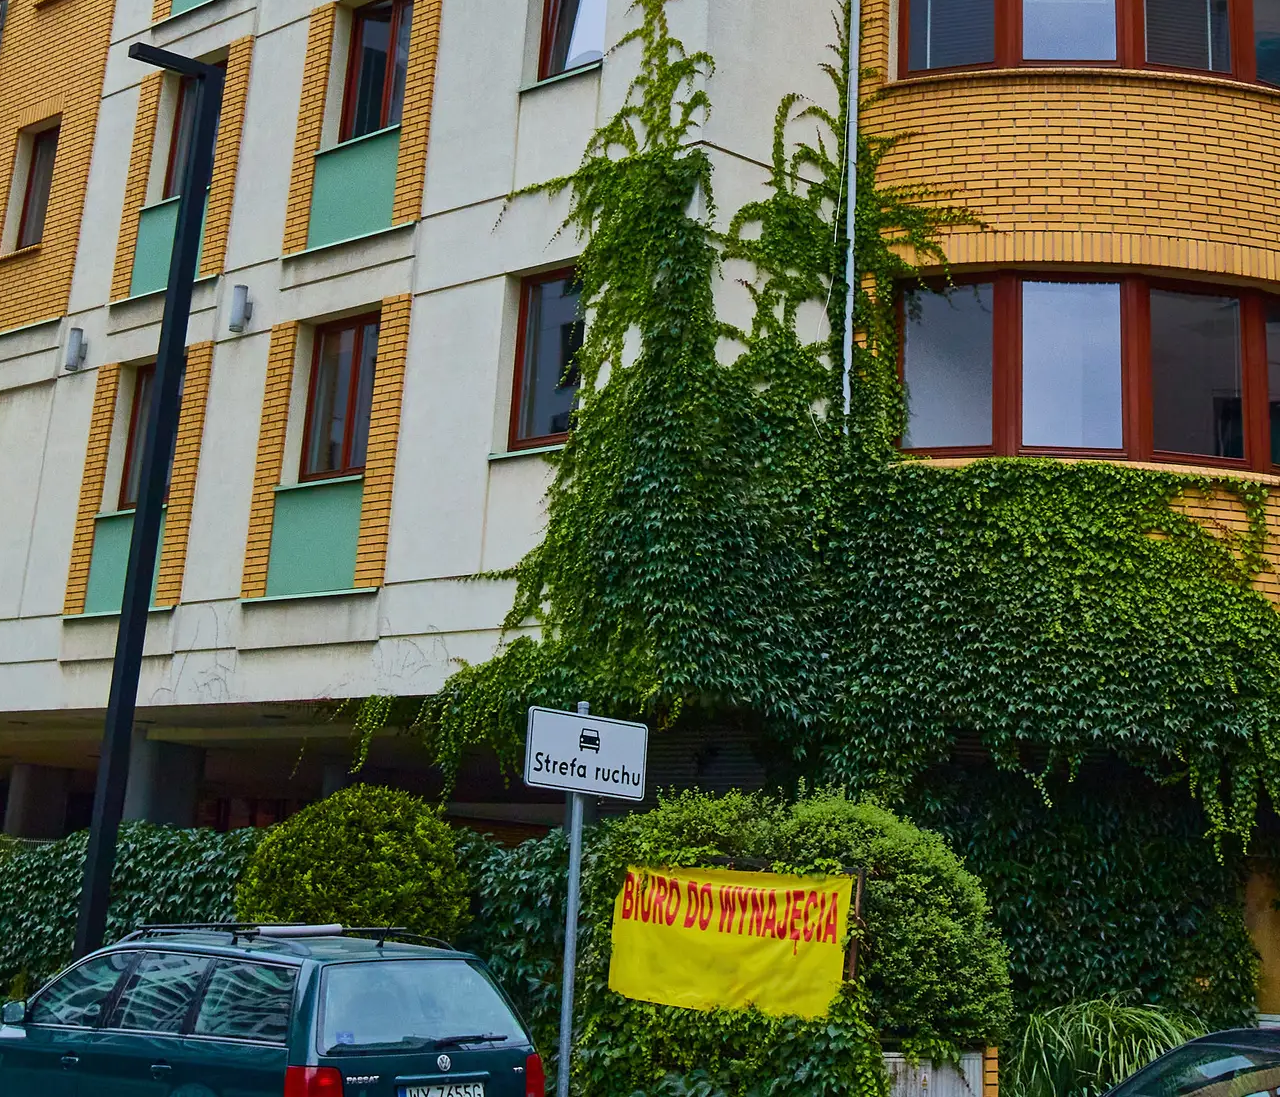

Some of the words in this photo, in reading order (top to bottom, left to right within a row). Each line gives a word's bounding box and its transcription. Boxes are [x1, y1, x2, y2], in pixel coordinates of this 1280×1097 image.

[533, 751, 587, 779] Strefa
[595, 764, 641, 786] ruchu
[622, 872, 681, 927] BIURO
[684, 881, 714, 931] DO
[719, 885, 839, 956] WYNAJĘCIA
[346, 1075, 380, 1085] PASSAT
